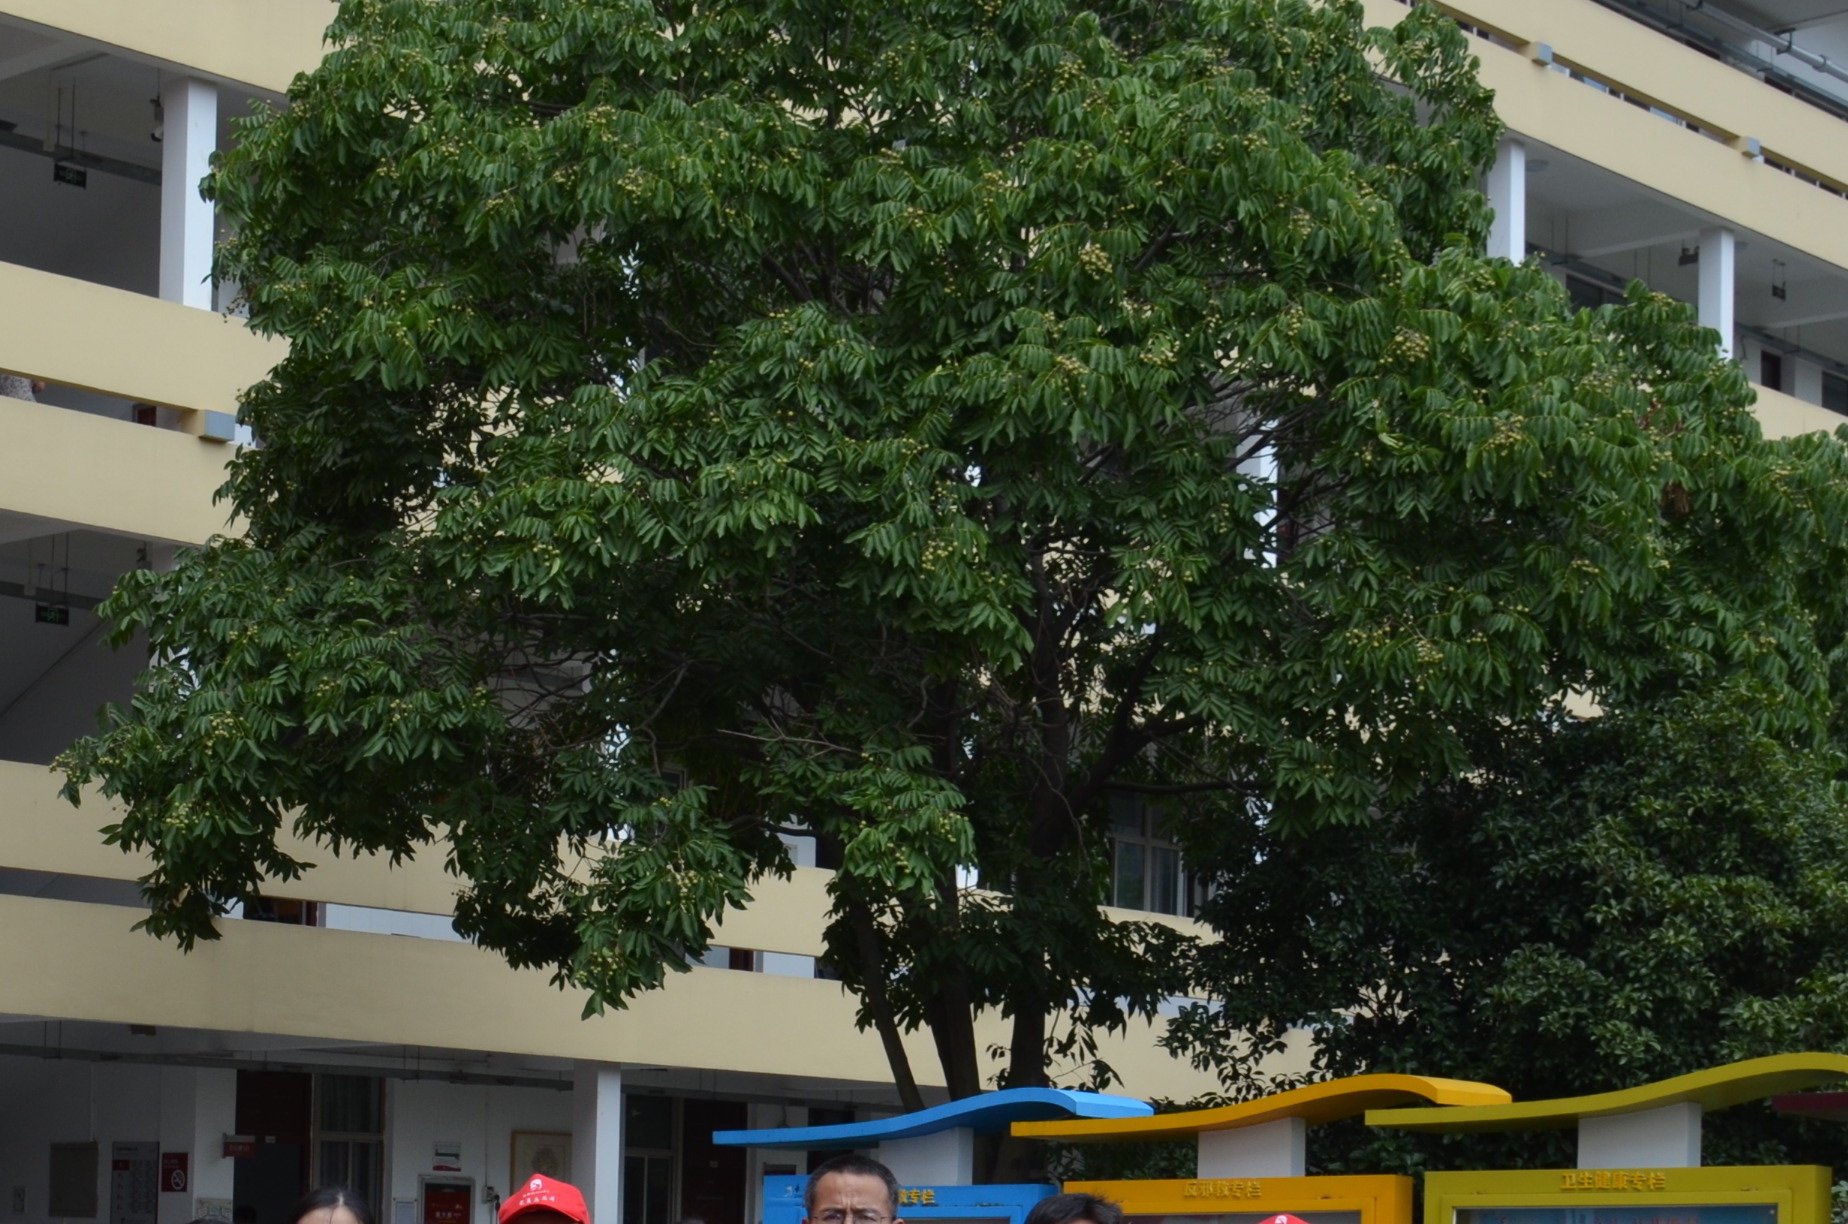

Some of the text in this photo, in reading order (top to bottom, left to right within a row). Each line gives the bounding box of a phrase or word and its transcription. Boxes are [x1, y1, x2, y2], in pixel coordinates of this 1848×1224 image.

[1183, 1180, 1263, 1199] 反邪教专栏
[1560, 1171, 1667, 1192] 卫生健康专栏
